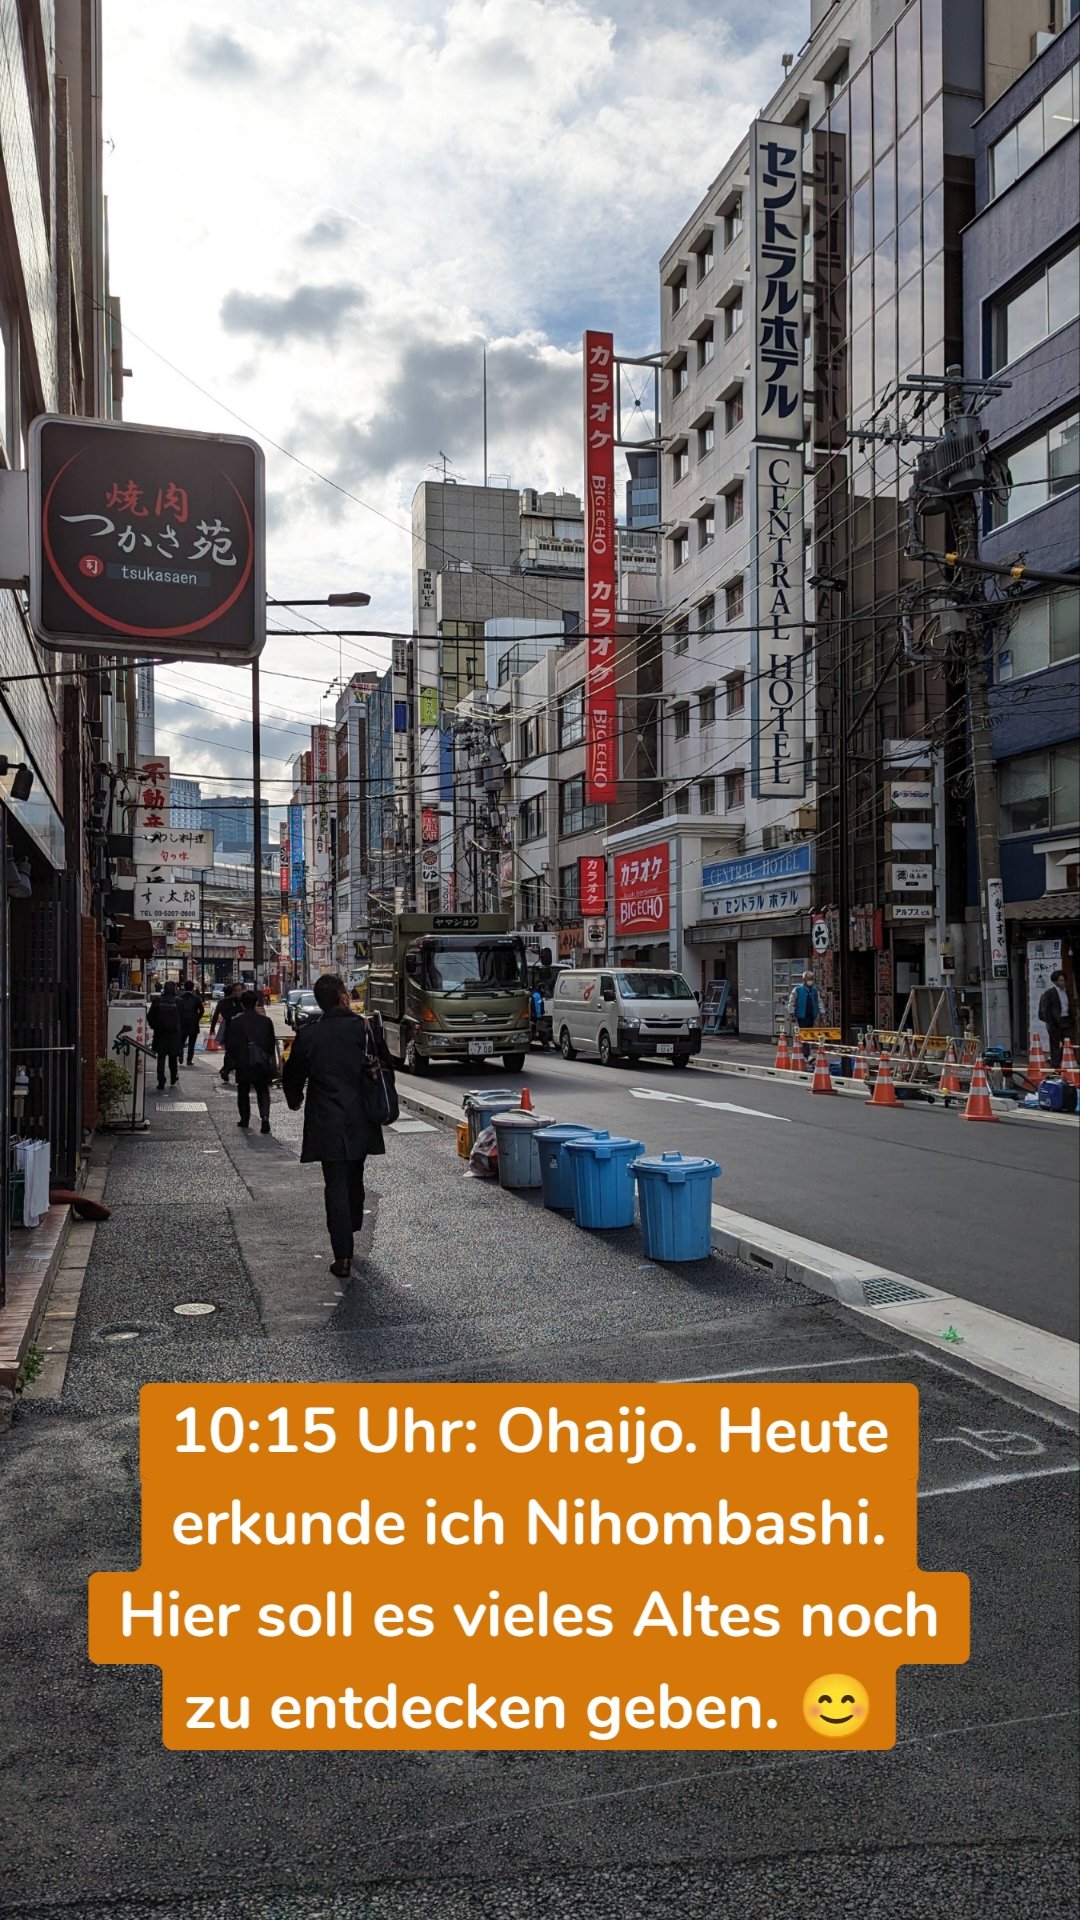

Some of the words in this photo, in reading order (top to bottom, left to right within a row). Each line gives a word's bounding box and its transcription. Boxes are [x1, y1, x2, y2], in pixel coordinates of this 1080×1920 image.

[759, 142, 799, 418] セントラルホテル
[590, 346, 610, 449] カラオケ
[105, 480, 189, 522] 焼肉
[60, 514, 237, 566] つかさ苑
[768, 459, 791, 640] CENTRAL
[122, 566, 197, 585] tsukasaen
[590, 581, 611, 683] カラオケ
[768, 654, 794, 783] HOTEL
[423, 831, 438, 840] CAFE
[160, 850, 190, 862] 旬の味
[621, 856, 663, 886] カラオケ
[710, 864, 755, 885] CENTRAL
[762, 854, 800, 876] HOTEL
[423, 871, 438, 880] UP
[586, 860, 598, 904] カラオケ
[725, 890, 798, 914] セントラルホテル
[434, 918, 478, 927] ヤマジョウ
